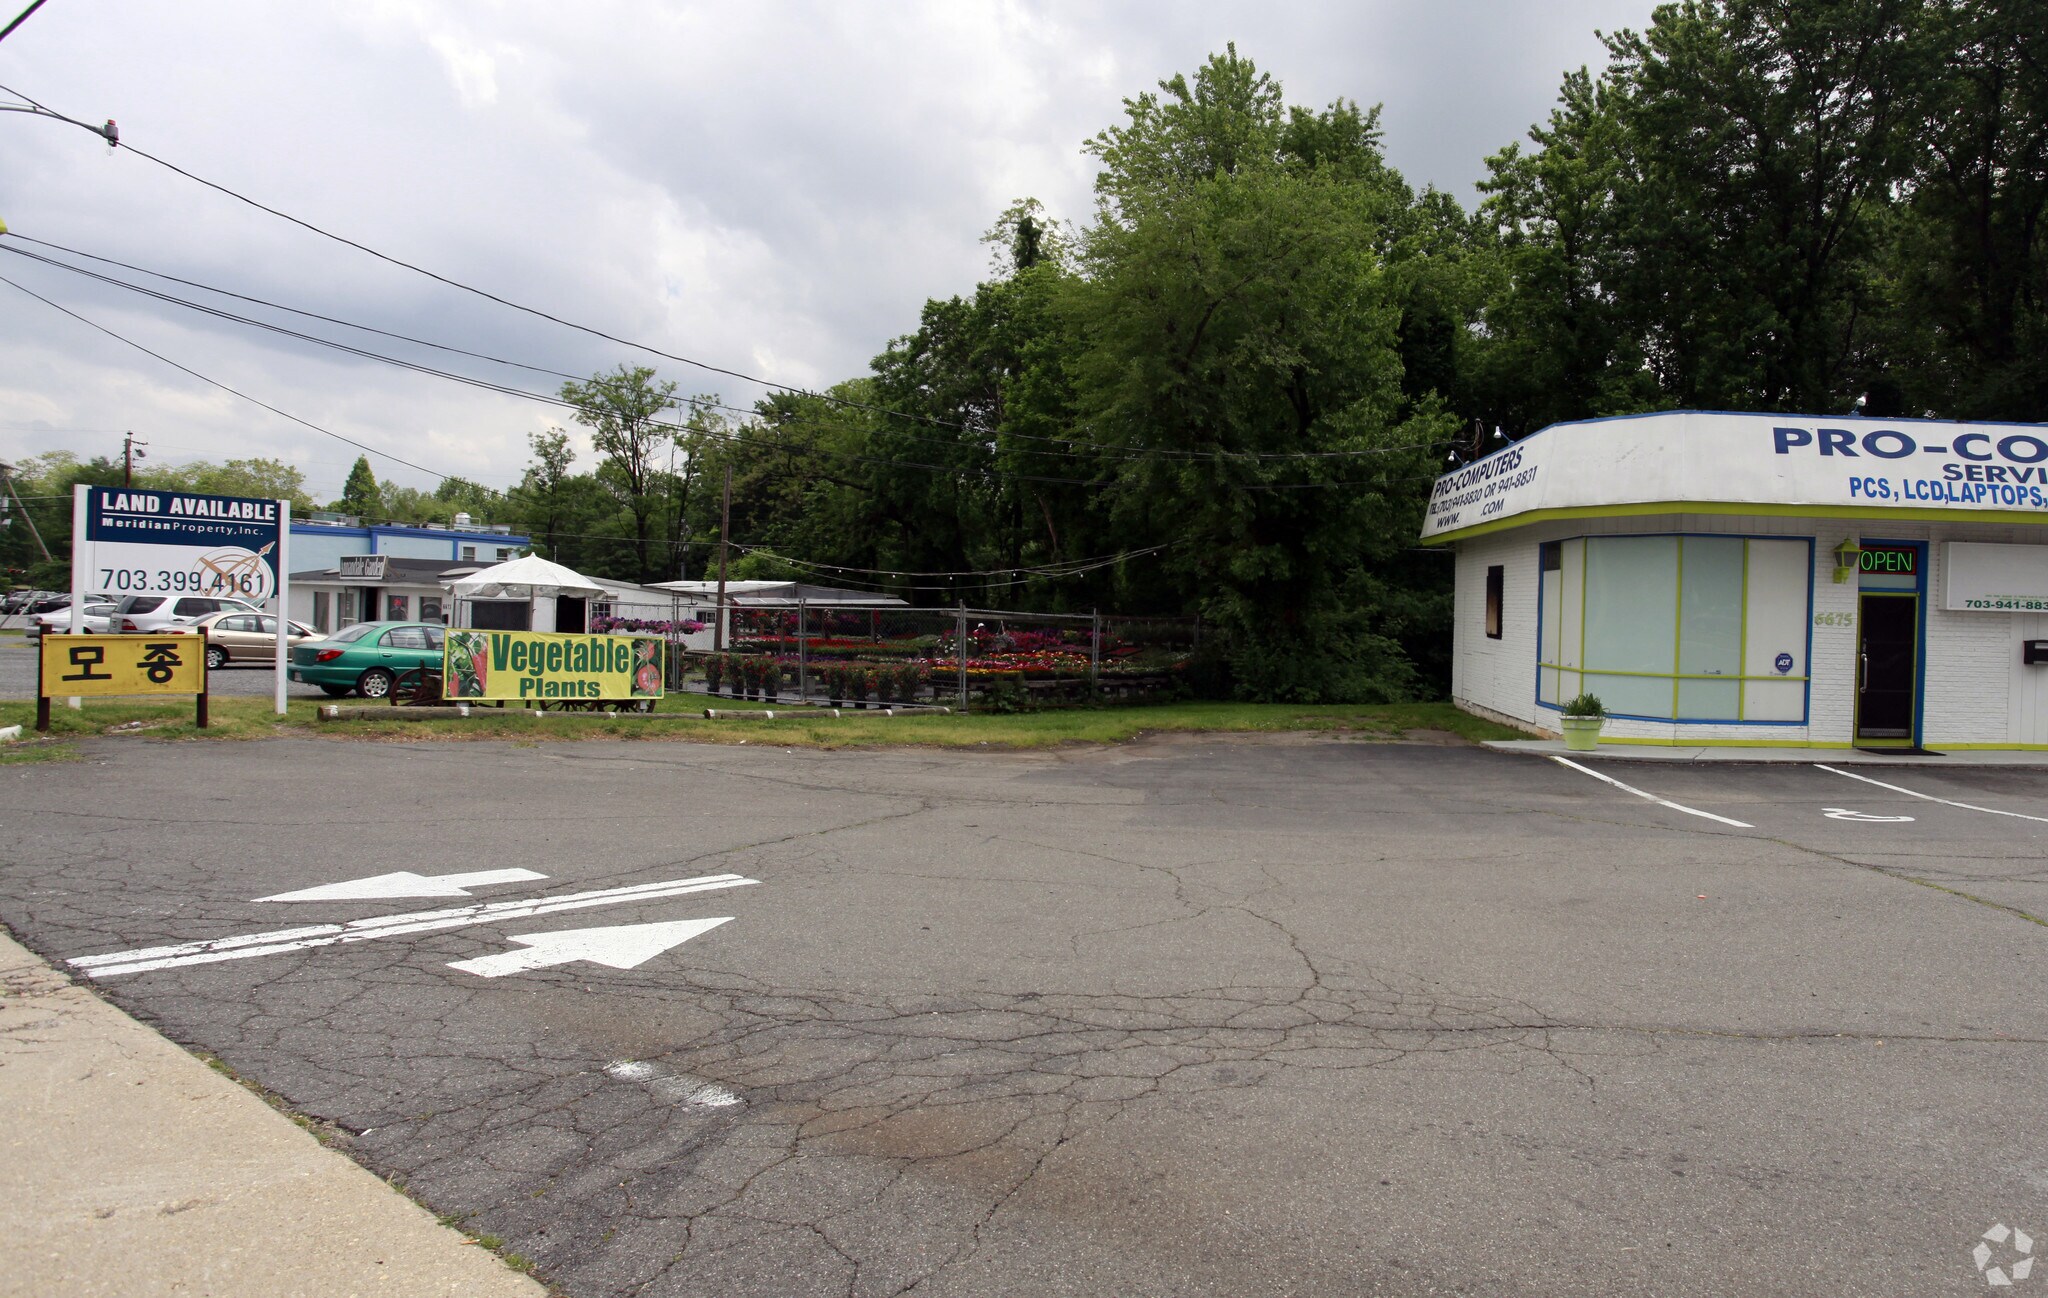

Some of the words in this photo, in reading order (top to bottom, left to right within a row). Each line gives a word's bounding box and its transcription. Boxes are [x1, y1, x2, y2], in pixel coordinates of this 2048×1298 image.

[1772, 427, 2048, 464] PRO-CO
[1433, 446, 1524, 499] PRO-COMPUTERS
[1484, 482, 1497, 498] OR
[1498, 466, 1538, 494] 941-8831
[1942, 463, 2048, 485] SERVI
[102, 492, 160, 513] LAND
[169, 498, 275, 520] AVAILABLE
[1860, 551, 1912, 571] OPEN
[100, 568, 264, 593] 703.399.4161
[1814, 611, 1853, 627] 6675
[491, 633, 629, 676] Vegetable
[1777, 658, 1791, 666] ADT
[519, 677, 600, 698] Plants
